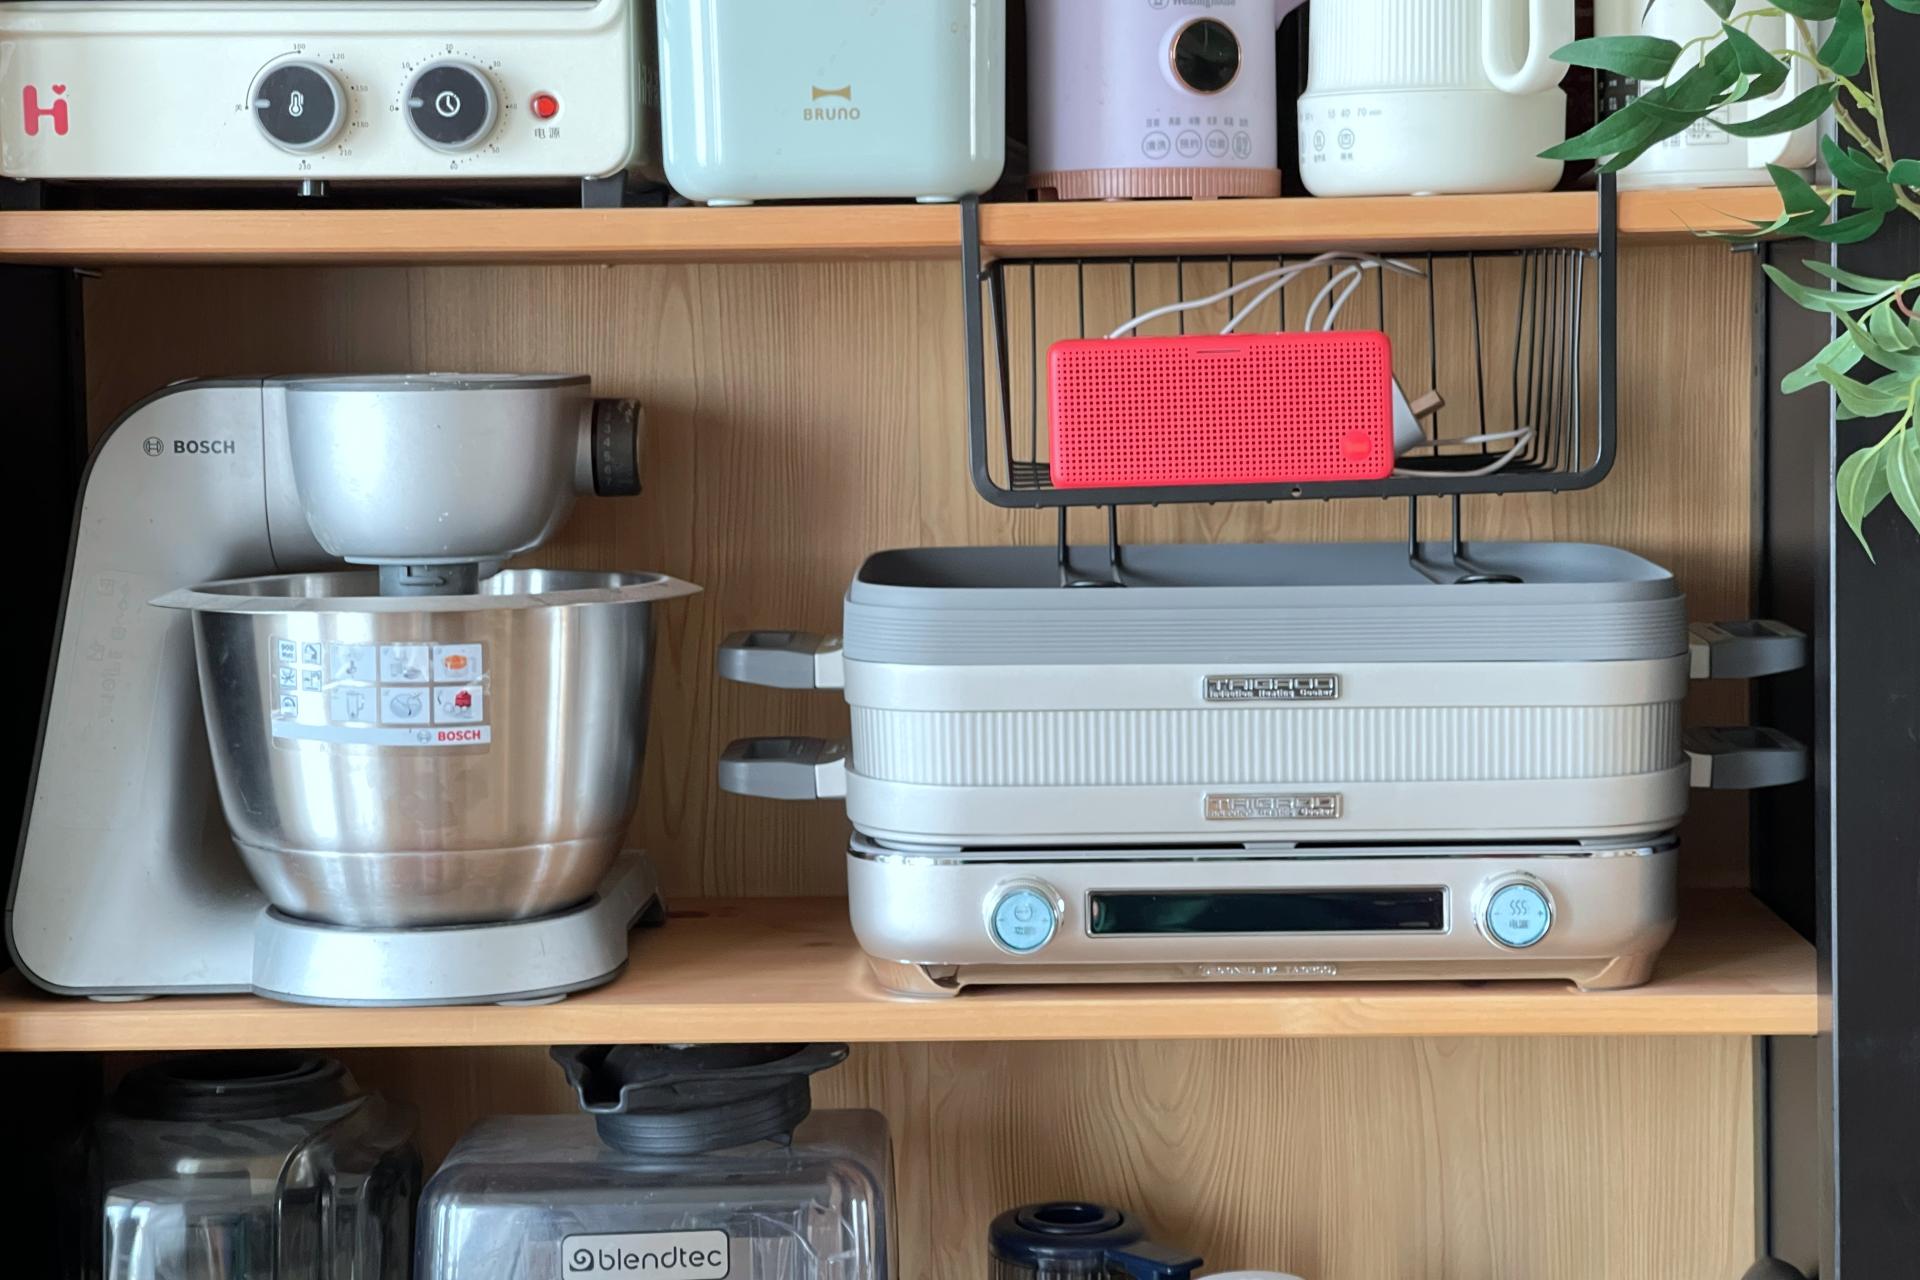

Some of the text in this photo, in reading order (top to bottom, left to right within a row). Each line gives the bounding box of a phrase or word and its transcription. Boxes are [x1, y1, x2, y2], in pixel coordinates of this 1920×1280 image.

[173, 440, 235, 454] BOSCH
[437, 730, 481, 741] BOSCH
[599, 1246, 722, 1271] blendtec
